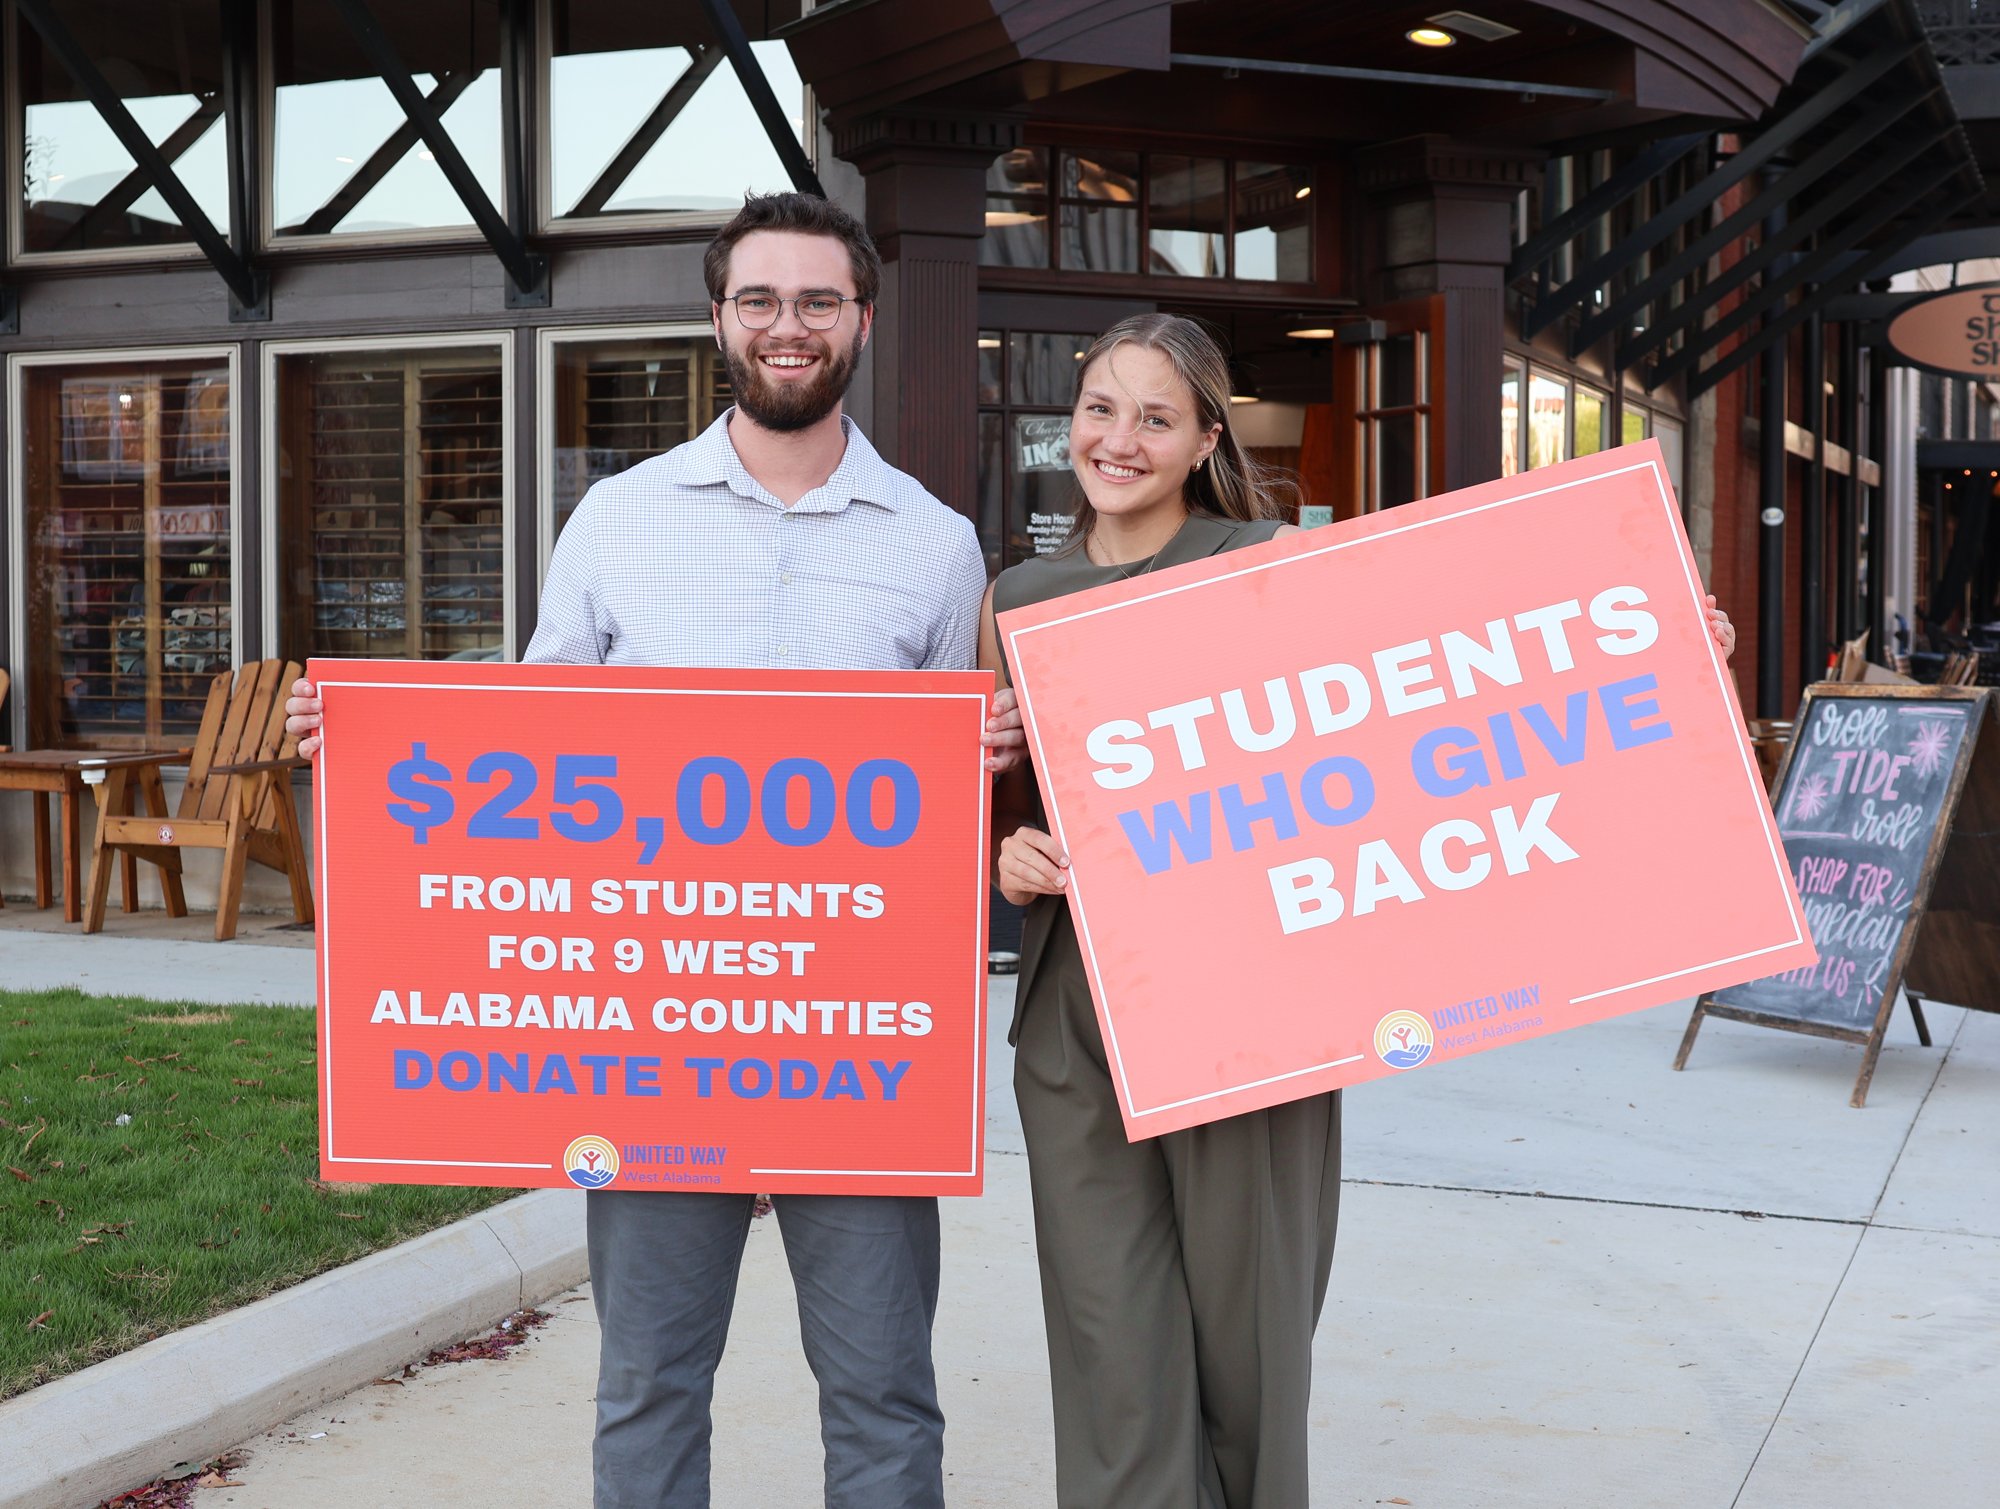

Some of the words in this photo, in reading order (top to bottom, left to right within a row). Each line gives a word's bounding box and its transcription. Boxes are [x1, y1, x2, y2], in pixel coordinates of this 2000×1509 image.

[1031, 512, 1052, 525] Store
[1085, 585, 1660, 790] STUDENTS
[1116, 755, 1376, 876] WHO
[1410, 673, 1674, 798] GIVE
[1832, 749, 1911, 801] TIDE
[386, 742, 921, 864] $25,000
[1267, 792, 1581, 935] BACK
[1798, 856, 1848, 895] SHOP
[1848, 863, 1892, 905] FOR
[419, 874, 571, 913] FROM
[591, 878, 885, 918] STUDENTS
[488, 935, 595, 972] FOR
[614, 938, 644, 973] 9
[661, 939, 815, 976] WEST
[1823, 956, 1856, 997] US
[370, 990, 634, 1031] ALABAMA
[652, 997, 933, 1036] COUNTIES
[1433, 996, 1499, 1030] UNITED
[1500, 984, 1541, 1011] WAY
[1440, 1033, 1478, 1050] West
[1482, 1016, 1544, 1041] Alabama
[393, 1049, 661, 1096] DONATE
[685, 1057, 912, 1101] TODAY
[623, 1171, 659, 1182] West
[662, 1171, 721, 1184] Alabama
[624, 1145, 685, 1164] UNITED
[689, 1146, 727, 1165] WAY
